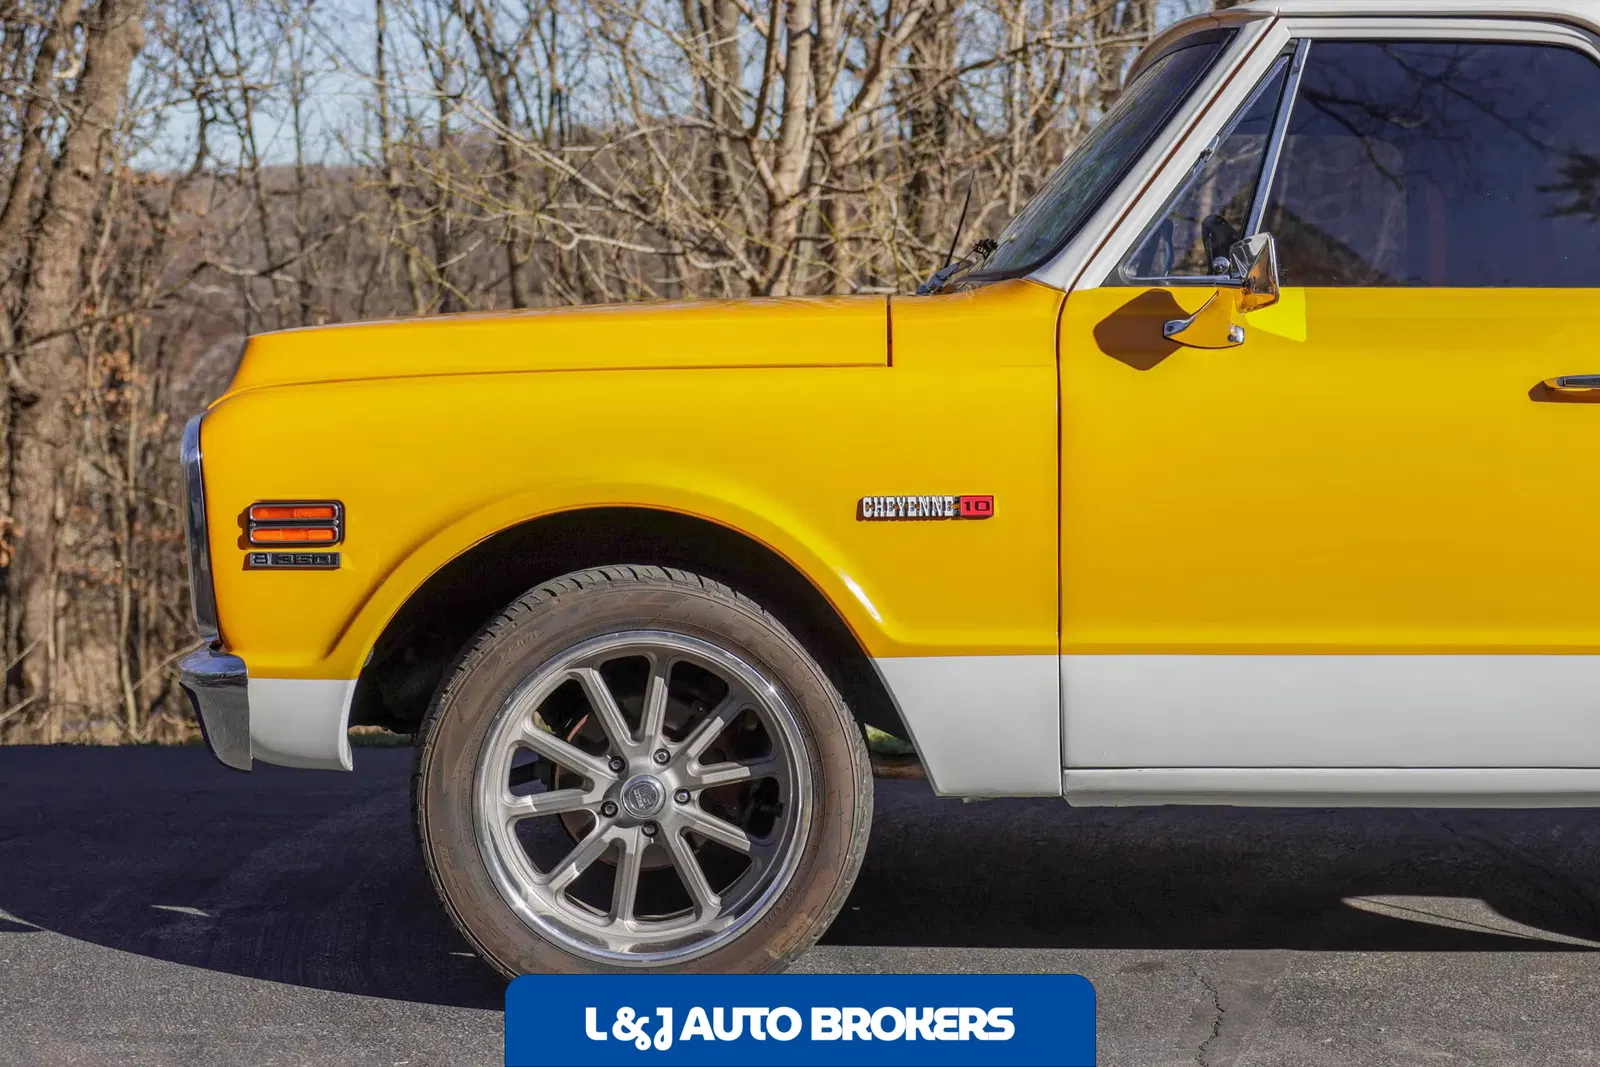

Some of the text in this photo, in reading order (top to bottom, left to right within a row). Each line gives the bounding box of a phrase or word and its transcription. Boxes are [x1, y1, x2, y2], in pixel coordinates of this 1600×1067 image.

[862, 496, 991, 517] CHEYENNE 10
[278, 554, 331, 565] 350
